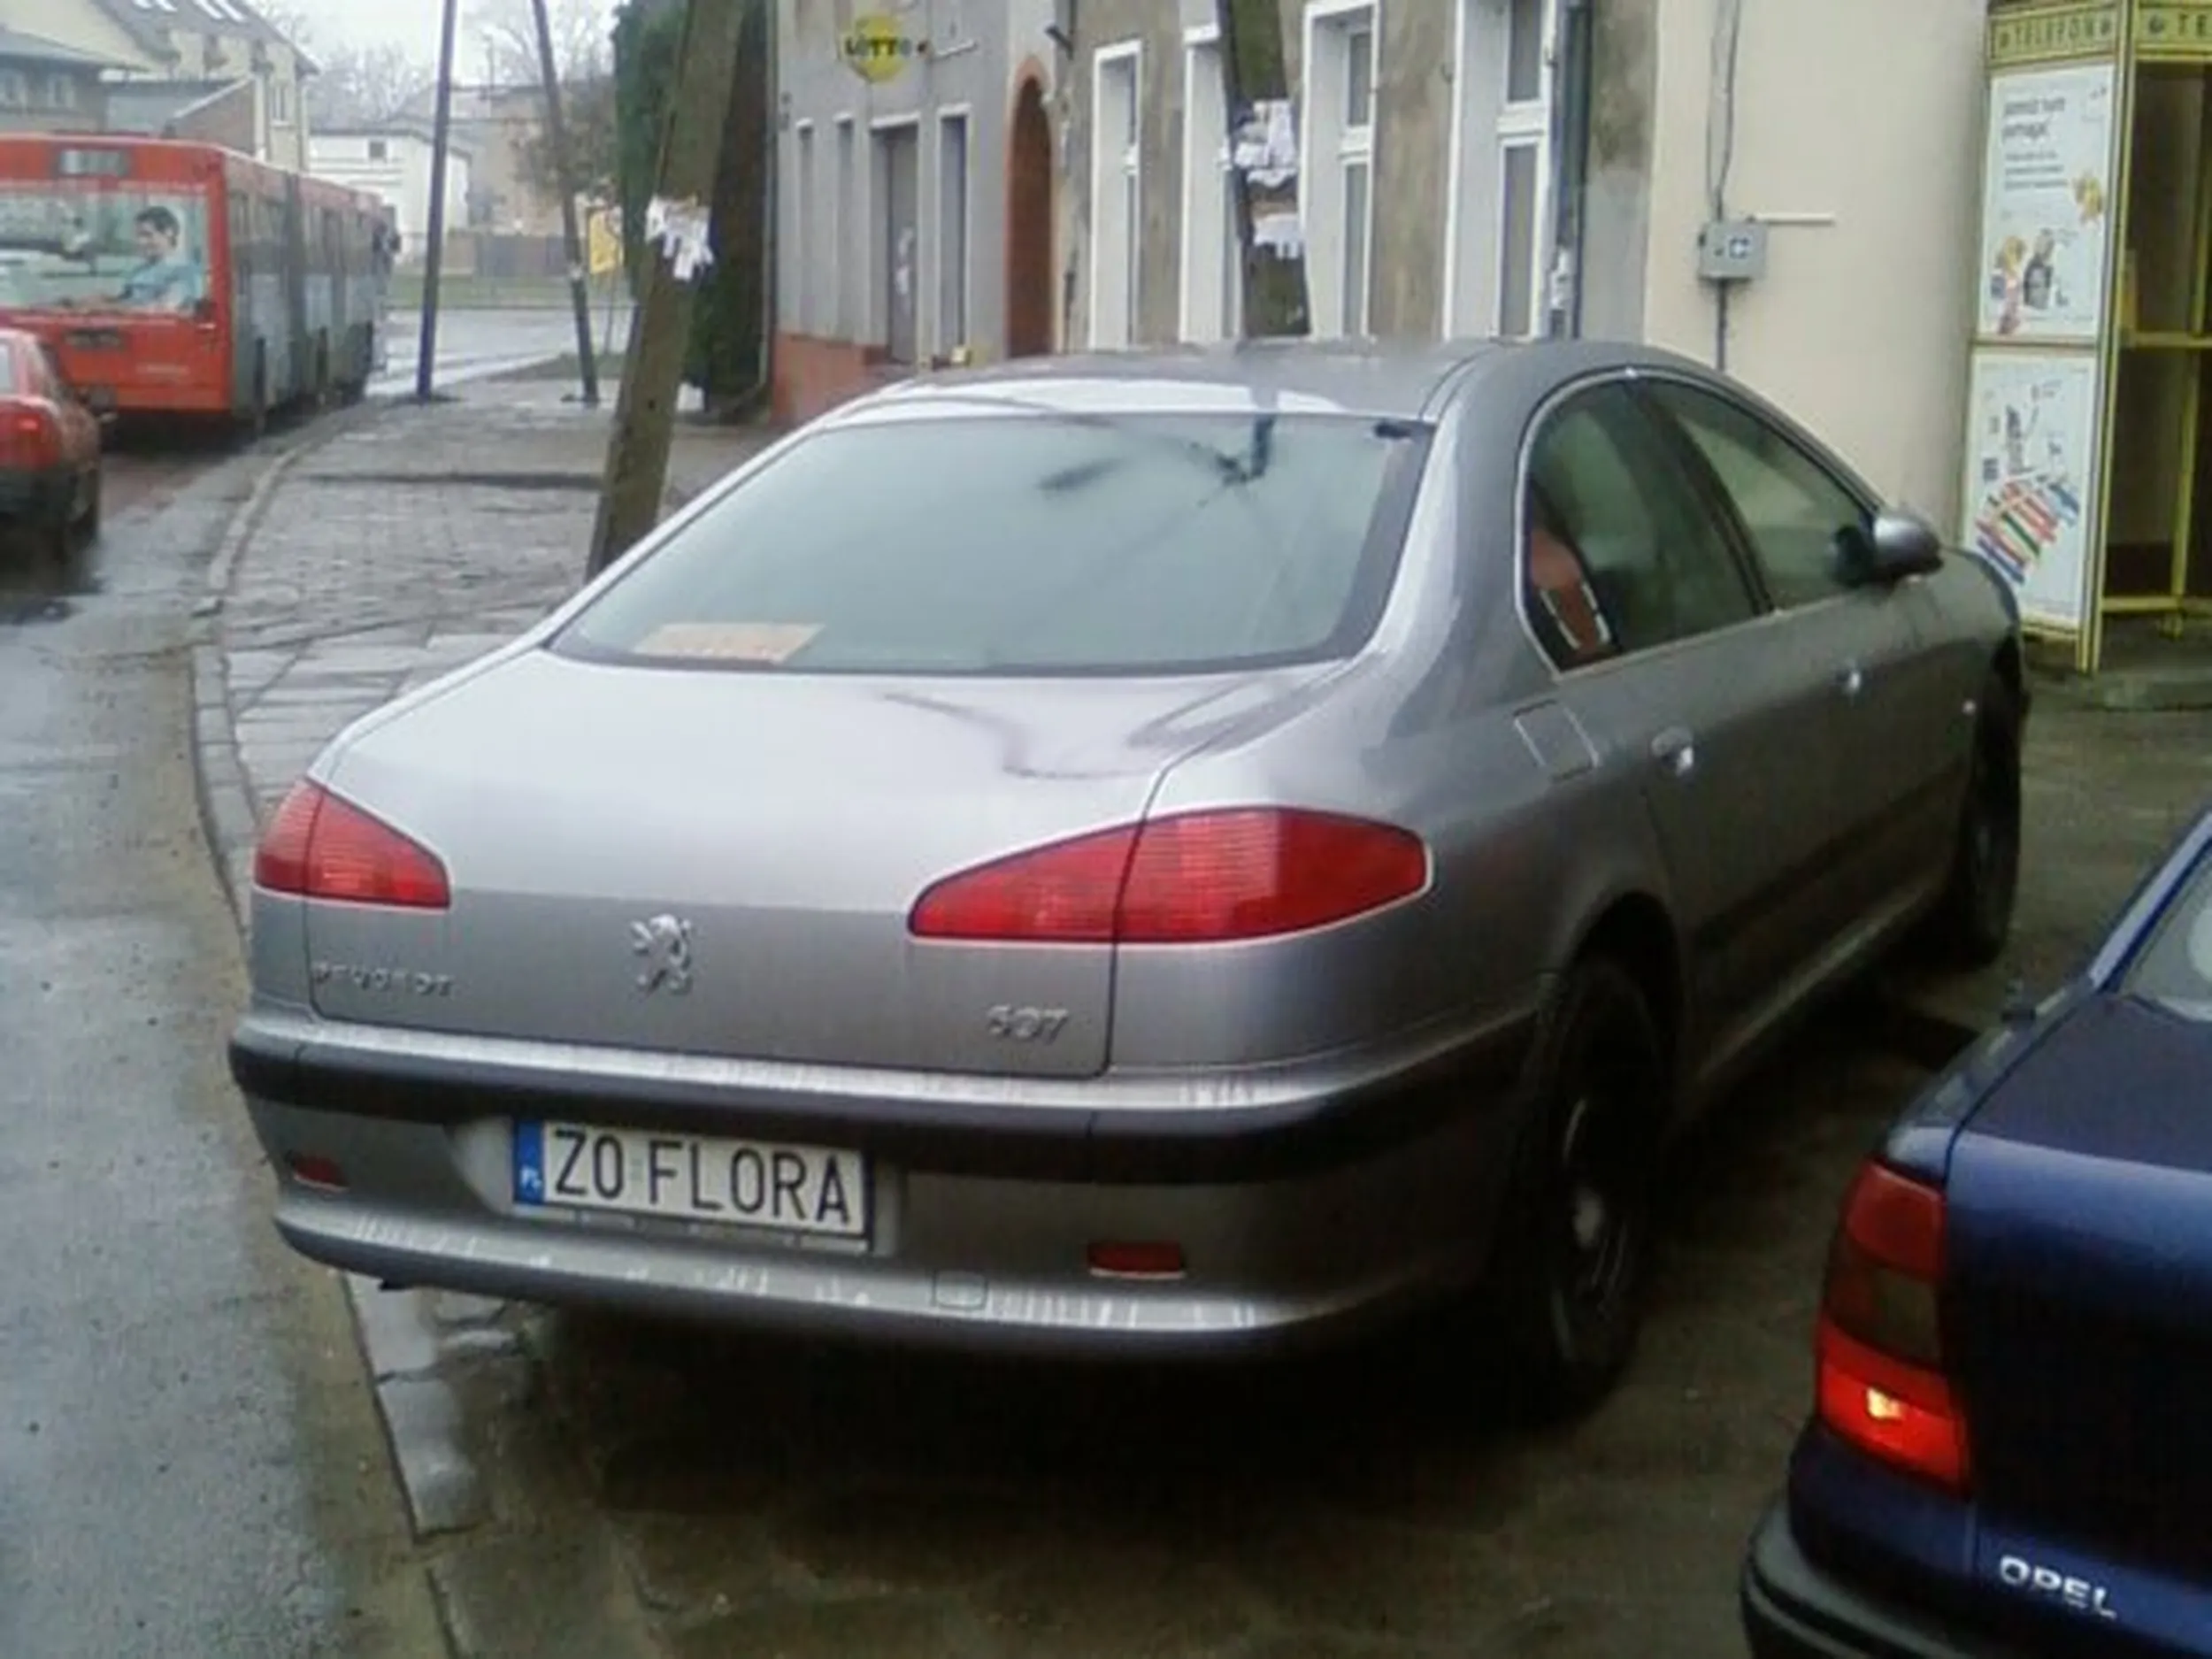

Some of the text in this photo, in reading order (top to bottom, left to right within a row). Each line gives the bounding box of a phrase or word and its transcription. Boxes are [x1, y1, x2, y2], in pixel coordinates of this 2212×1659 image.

[845, 36, 912, 57] LOTTO
[648, 1138, 852, 1225] FLORA
[2000, 1555, 2116, 1619] OPEL
